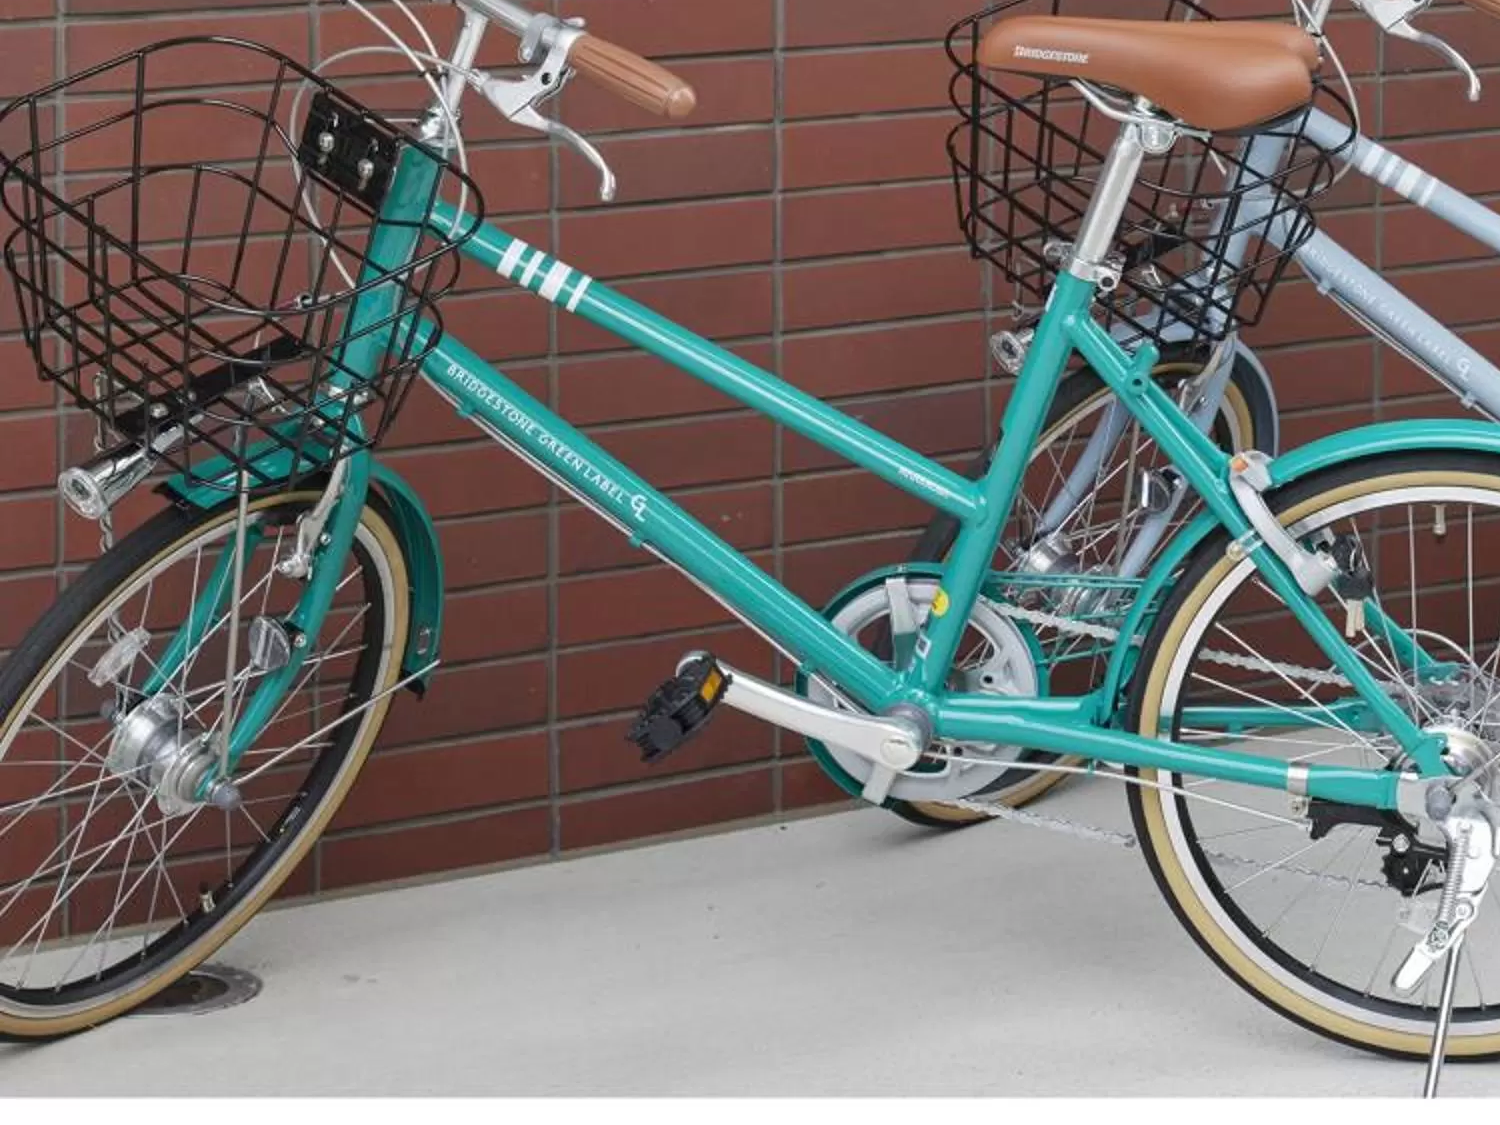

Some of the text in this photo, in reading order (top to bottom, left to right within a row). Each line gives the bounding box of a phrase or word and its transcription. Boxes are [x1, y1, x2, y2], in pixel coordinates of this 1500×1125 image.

[447, 364, 535, 436] BRIDGESTONE
[537, 430, 584, 473] GREEN
[583, 465, 627, 504] LABEL
